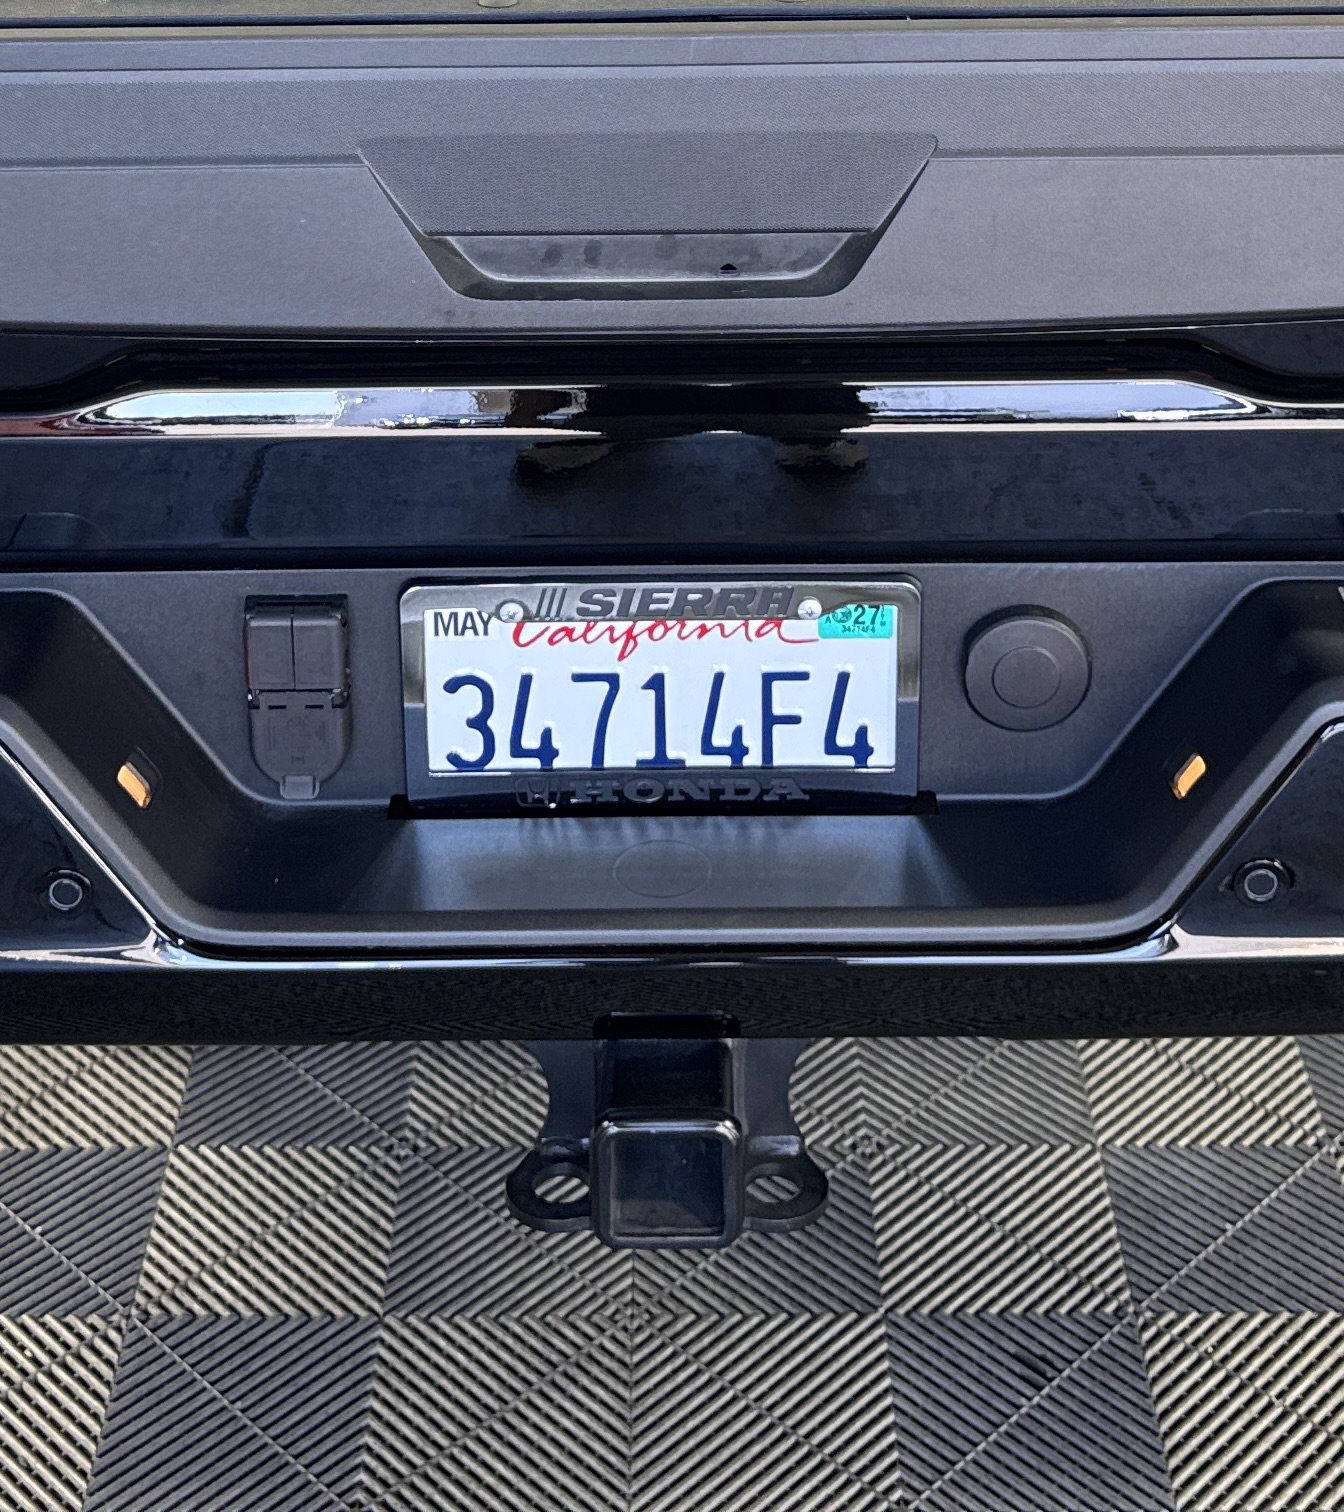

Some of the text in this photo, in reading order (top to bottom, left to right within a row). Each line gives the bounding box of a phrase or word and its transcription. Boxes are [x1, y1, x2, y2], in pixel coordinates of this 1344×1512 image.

[576, 588, 794, 617] SIERRA
[854, 604, 881, 625] 27
[433, 611, 493, 637] MAY
[442, 671, 874, 771] 34714F4
[568, 778, 811, 802] HONDA
